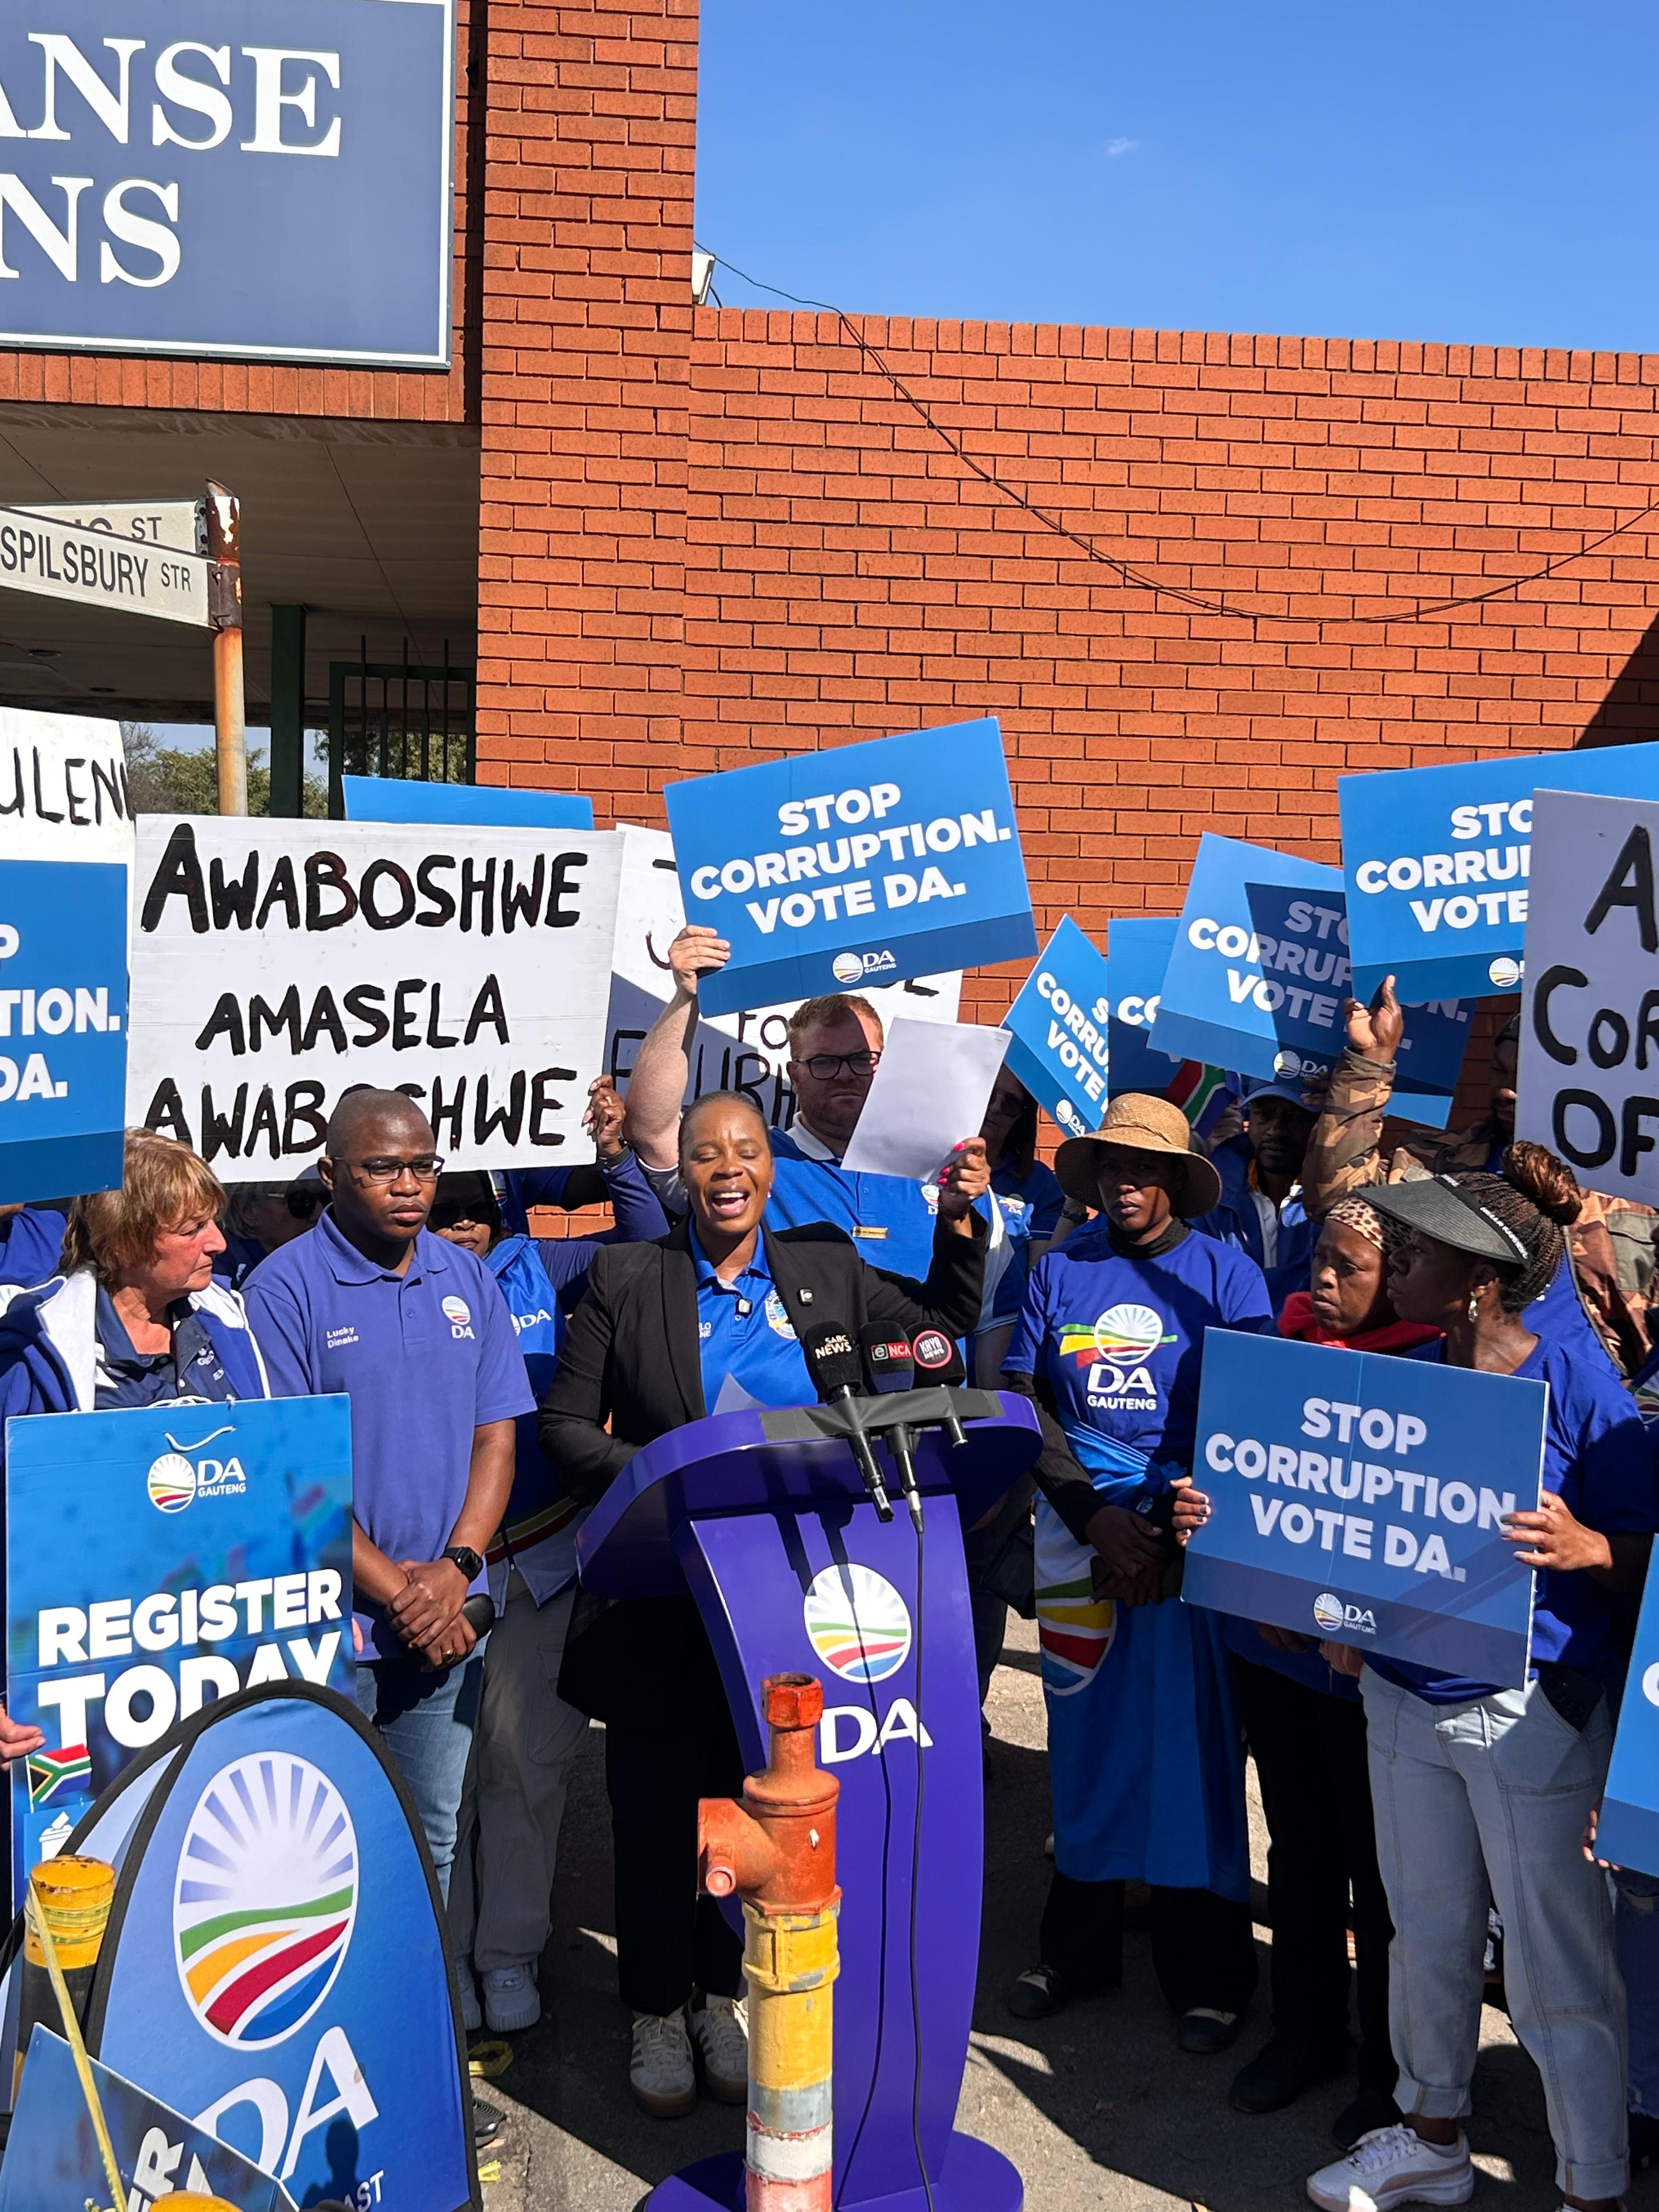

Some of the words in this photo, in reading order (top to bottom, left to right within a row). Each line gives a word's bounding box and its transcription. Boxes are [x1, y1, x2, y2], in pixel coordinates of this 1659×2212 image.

[1, 526, 148, 597] SPILSBURY
[161, 562, 191, 592] STR
[778, 783, 901, 837] STOP
[141, 823, 588, 936] AWABOSHWE
[690, 809, 1012, 900] CORRUPTION.
[745, 883, 875, 934] VOTE
[883, 866, 967, 910] DA.
[1409, 889, 1529, 932] VOTE
[1583, 823, 1658, 953] A
[862, 950, 895, 968] DA
[195, 973, 510, 1056] AMASELA
[1037, 972, 1109, 1074] CORRU
[1227, 968, 1339, 1028] VOTE
[1047, 1019, 1106, 1102] VOTE
[144, 1068, 578, 1162] AWABHWE
[326, 1327, 355, 1339] Lucky
[452, 1325, 475, 1339] DA
[520, 1308, 552, 1329] DA
[825, 1334, 849, 1345] SABC
[919, 1336, 942, 1354] KAYA
[815, 1341, 852, 1359] NEWS
[1087, 1363, 1158, 1396] DA
[1087, 1395, 1157, 1410] GAUTENG
[1301, 1397, 1427, 1454] STOP
[198, 1457, 246, 1482] DA
[198, 1482, 246, 1498] GAUTENG
[1205, 1433, 1517, 1531] CORRUPTION
[1249, 1493, 1372, 1560] VOTE
[1384, 1525, 1466, 1582] DA.
[38, 1569, 343, 1667] REGISTER
[1344, 1604, 1377, 1628] DA
[820, 1697, 934, 1764] DA
[193, 2026, 379, 2183] DA
